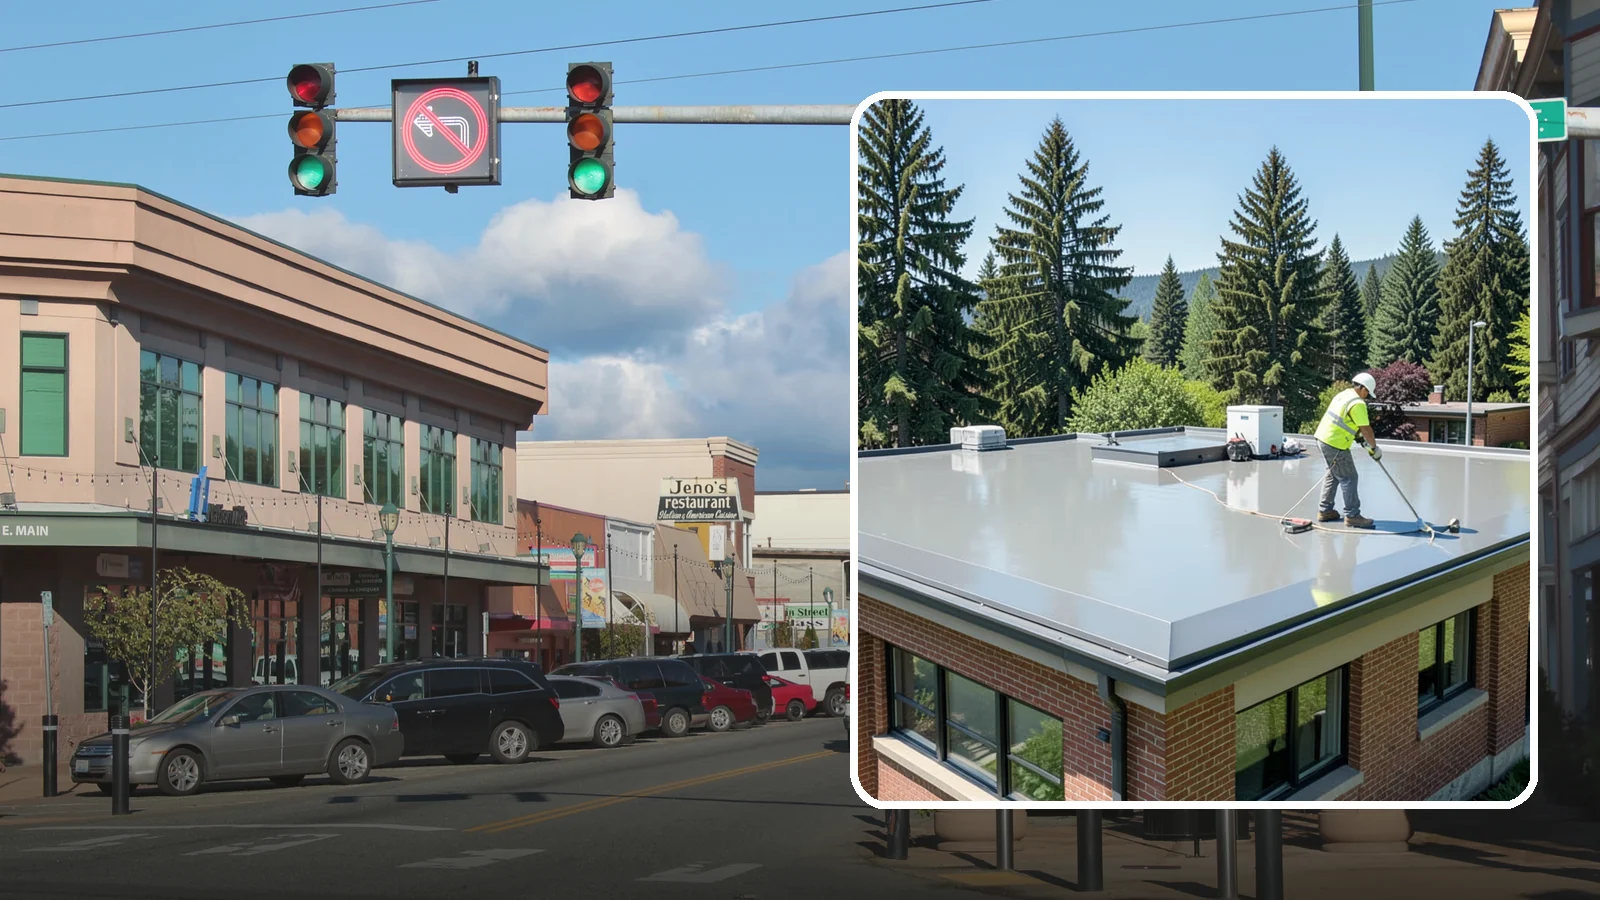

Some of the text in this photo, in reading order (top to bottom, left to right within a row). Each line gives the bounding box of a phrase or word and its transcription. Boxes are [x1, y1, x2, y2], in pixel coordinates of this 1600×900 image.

[669, 480, 727, 495] Jeno's
[665, 496, 731, 509] restaurant
[658, 509, 682, 519] Italian
[686, 509, 714, 519] American
[715, 509, 737, 519] Cuisine
[2, 525, 49, 536] E. MAIN
[797, 607, 828, 617] Street
